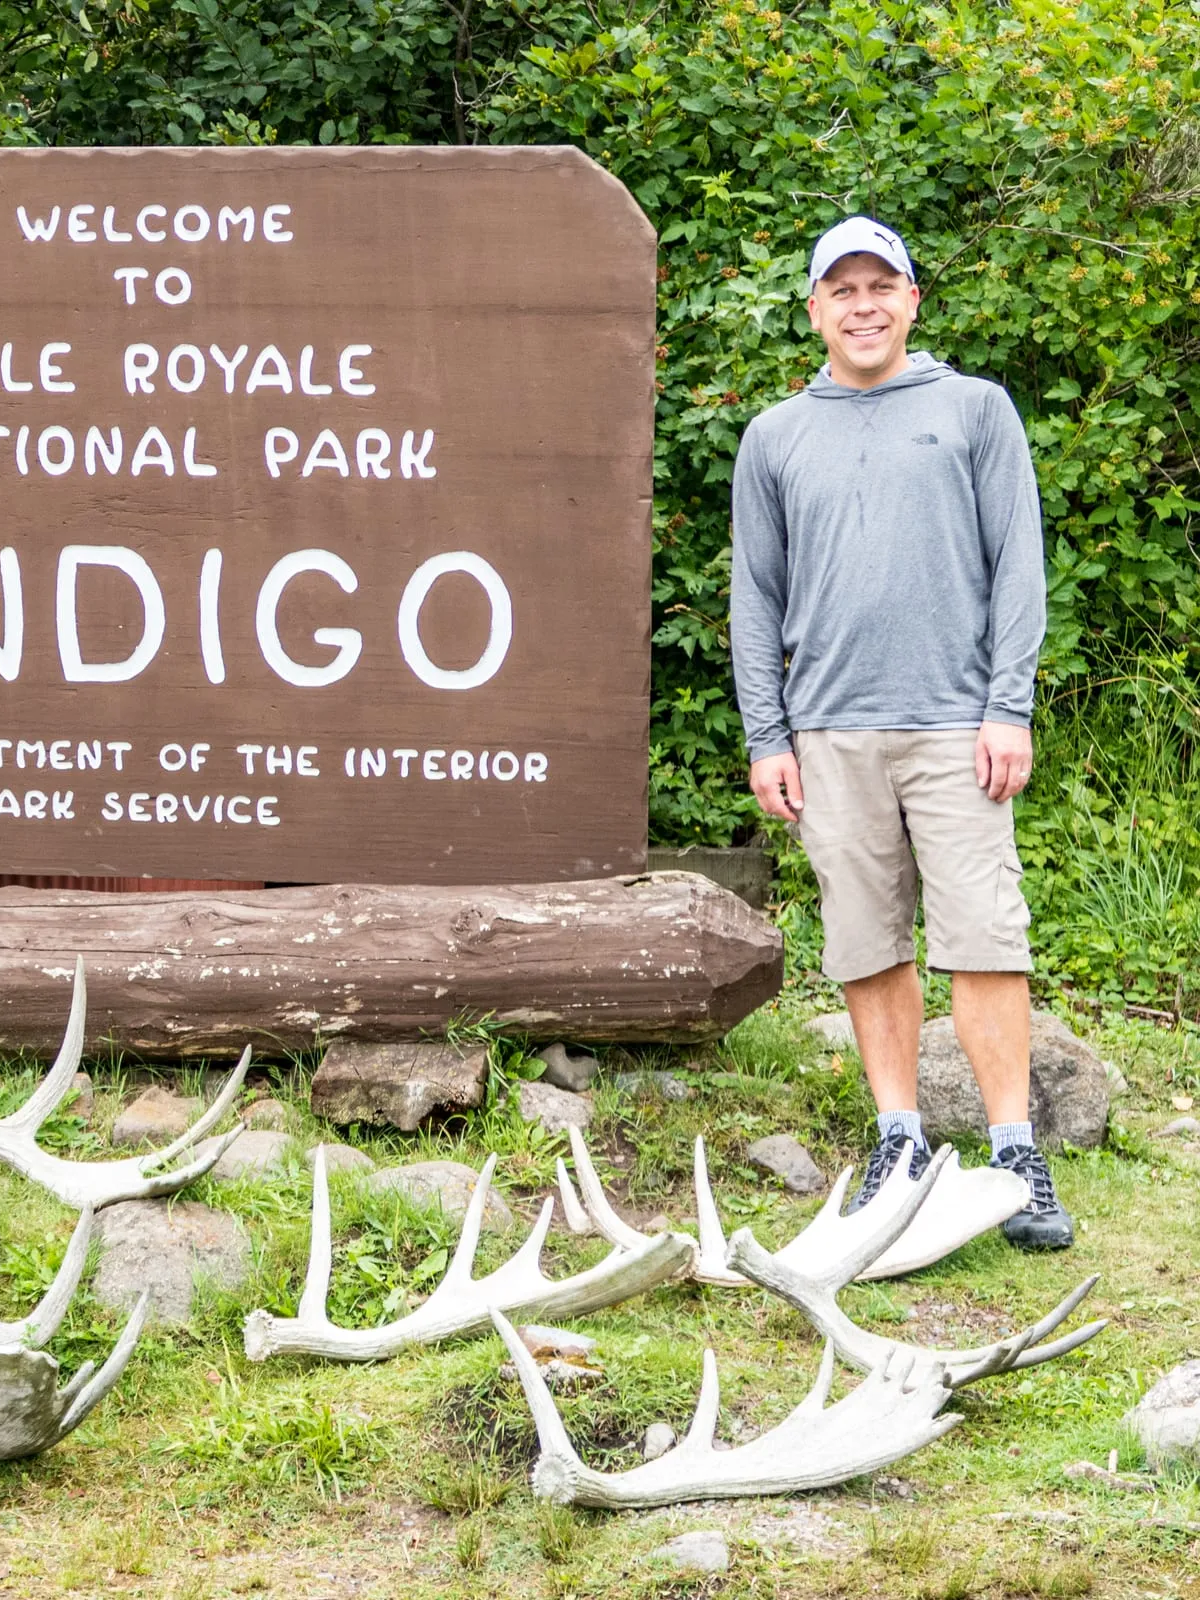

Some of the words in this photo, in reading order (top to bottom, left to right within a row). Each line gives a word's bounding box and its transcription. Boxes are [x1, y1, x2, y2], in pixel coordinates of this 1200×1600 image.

[16, 204, 294, 244] WELCOME
[113, 266, 192, 306] TO
[123, 342, 377, 397] ROYALE
[264, 426, 437, 480] PARK
[158, 742, 211, 773] OF
[236, 743, 321, 777] THE
[344, 747, 549, 783] INTERIOR
[101, 791, 281, 826] SERVICE
